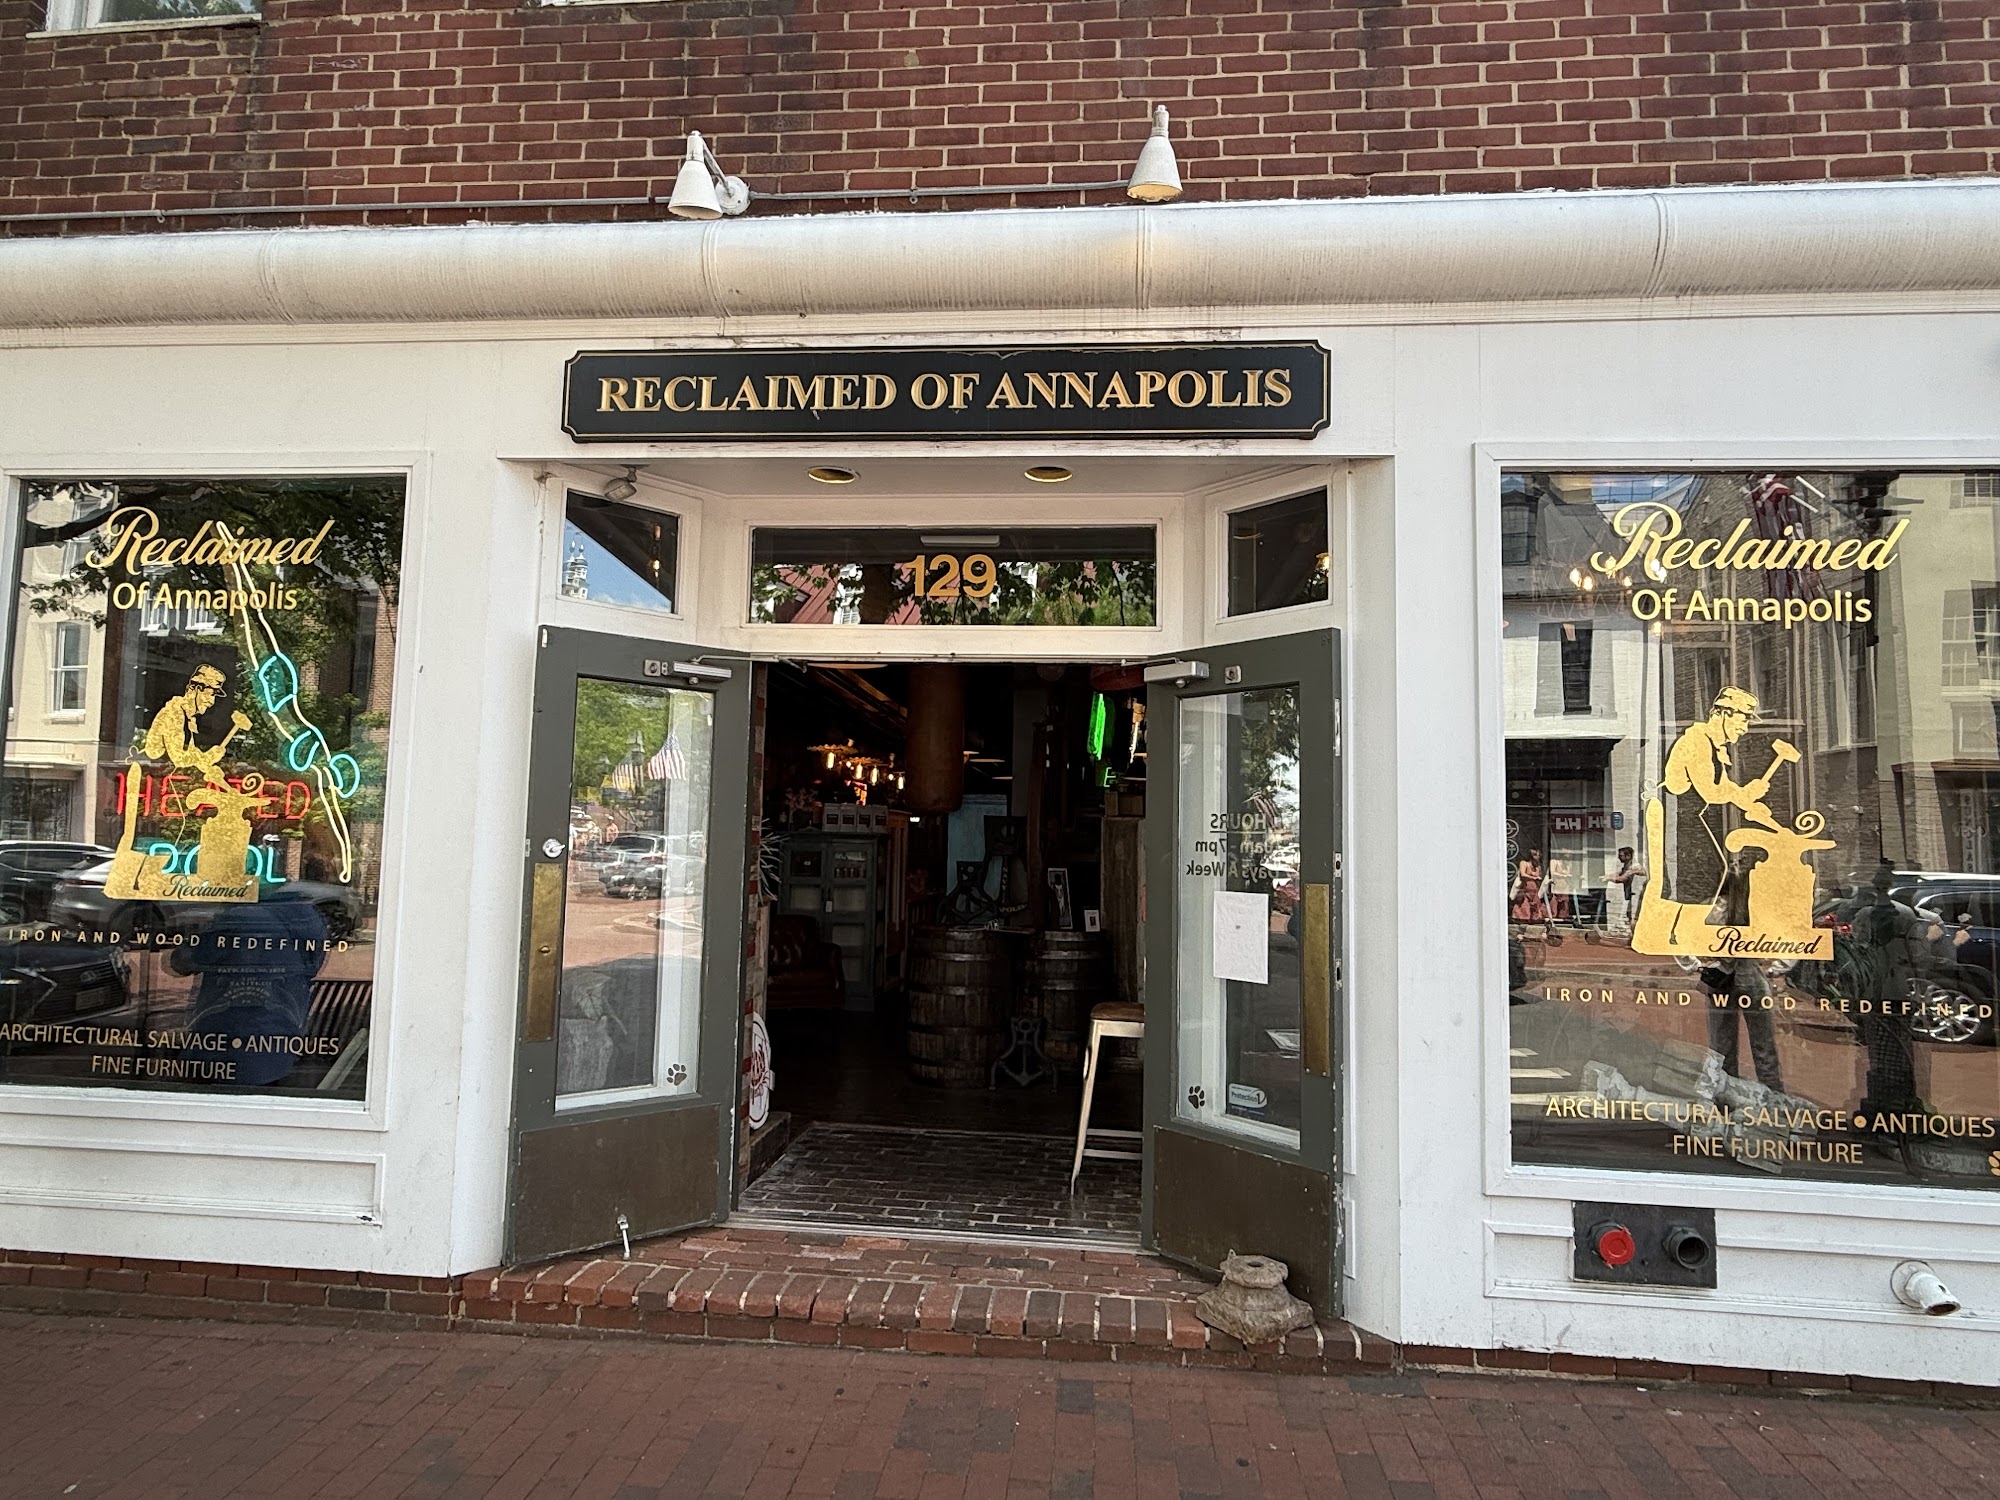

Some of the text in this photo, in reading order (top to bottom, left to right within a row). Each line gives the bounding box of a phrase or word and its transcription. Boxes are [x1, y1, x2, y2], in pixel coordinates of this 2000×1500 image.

[597, 368, 1292, 413] RECLAIMED OF ANNAPOLIS
[86, 506, 335, 576] Reclaimed
[1590, 501, 1910, 582] Reclaimed
[904, 554, 997, 600] 129
[113, 582, 298, 618] Of Annapolis
[1631, 588, 1872, 628] Of Annapolis
[163, 875, 250, 899] Reclaimed
[9, 929, 349, 953] IRON AND WOOD REDEFINED
[1708, 927, 1819, 955] Reclaimed
[1546, 988, 1993, 1019] IRON AND WOOD REDEFINED
[0, 1023, 340, 1056] ARCHITECTURAL SALVAGE ANTIQUES
[91, 1055, 236, 1080] FINE FURNITURE
[1546, 1097, 1996, 1138] ARCHITECTURAL SALVAGE ANTIQUES
[1672, 1135, 1863, 1165] FINE FURNITURE
